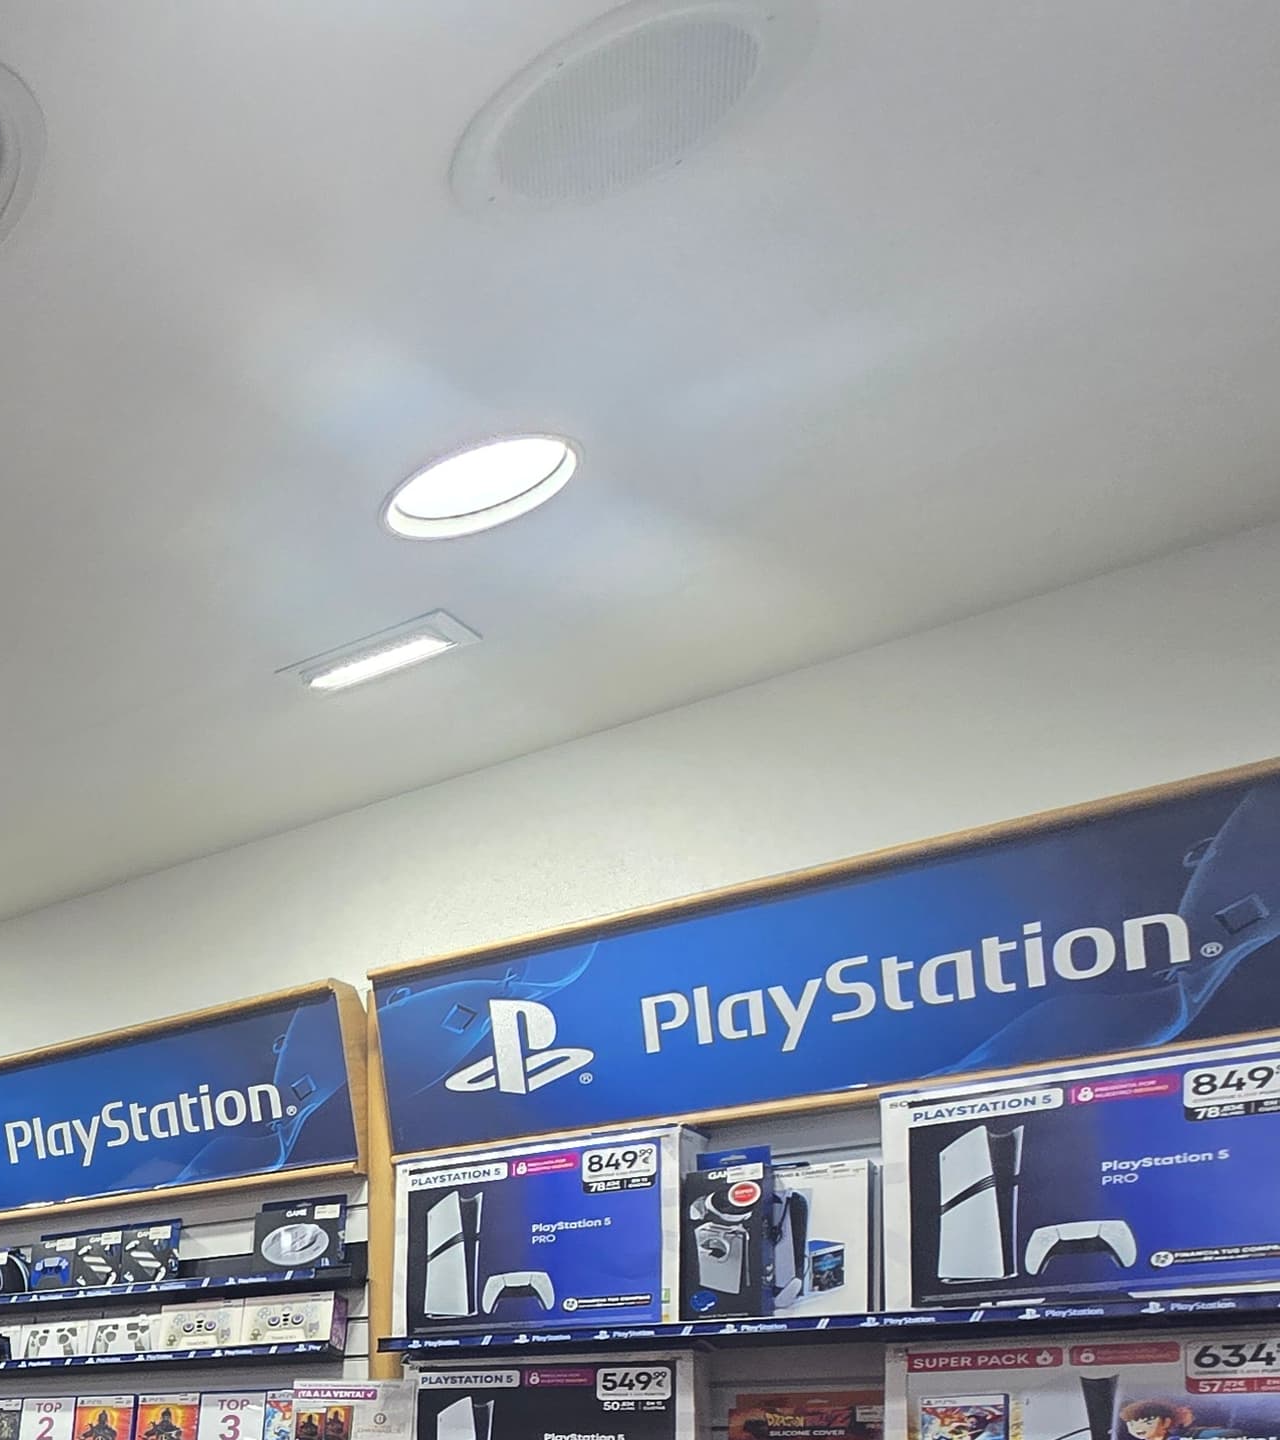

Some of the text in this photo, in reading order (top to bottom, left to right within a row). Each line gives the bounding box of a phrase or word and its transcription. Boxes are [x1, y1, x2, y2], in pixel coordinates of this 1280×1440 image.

[641, 912, 1190, 1054] PlayStation
[913, 1094, 1051, 1122] PLAYSTATION 5
[5, 1083, 283, 1167] PlayStation
[1102, 1150, 1230, 1172] PlayStation 5
[411, 1168, 501, 1187] PLAYSTATION 5
[1102, 1172, 1138, 1185] PRO
[532, 1217, 611, 1235] PlayStation 5
[532, 1233, 556, 1244] PRO
[1045, 1307, 1103, 1318] PlayStation
[1170, 1300, 1235, 1311] PlayStation
[913, 1352, 1029, 1370] SUPER PACK
[421, 1374, 513, 1385] PLAYSTATION 5
[35, 1403, 61, 1413] TOP
[218, 1399, 249, 1410] TOP
[36, 1417, 53, 1440] 2
[769, 1429, 810, 1437] SILICONE
